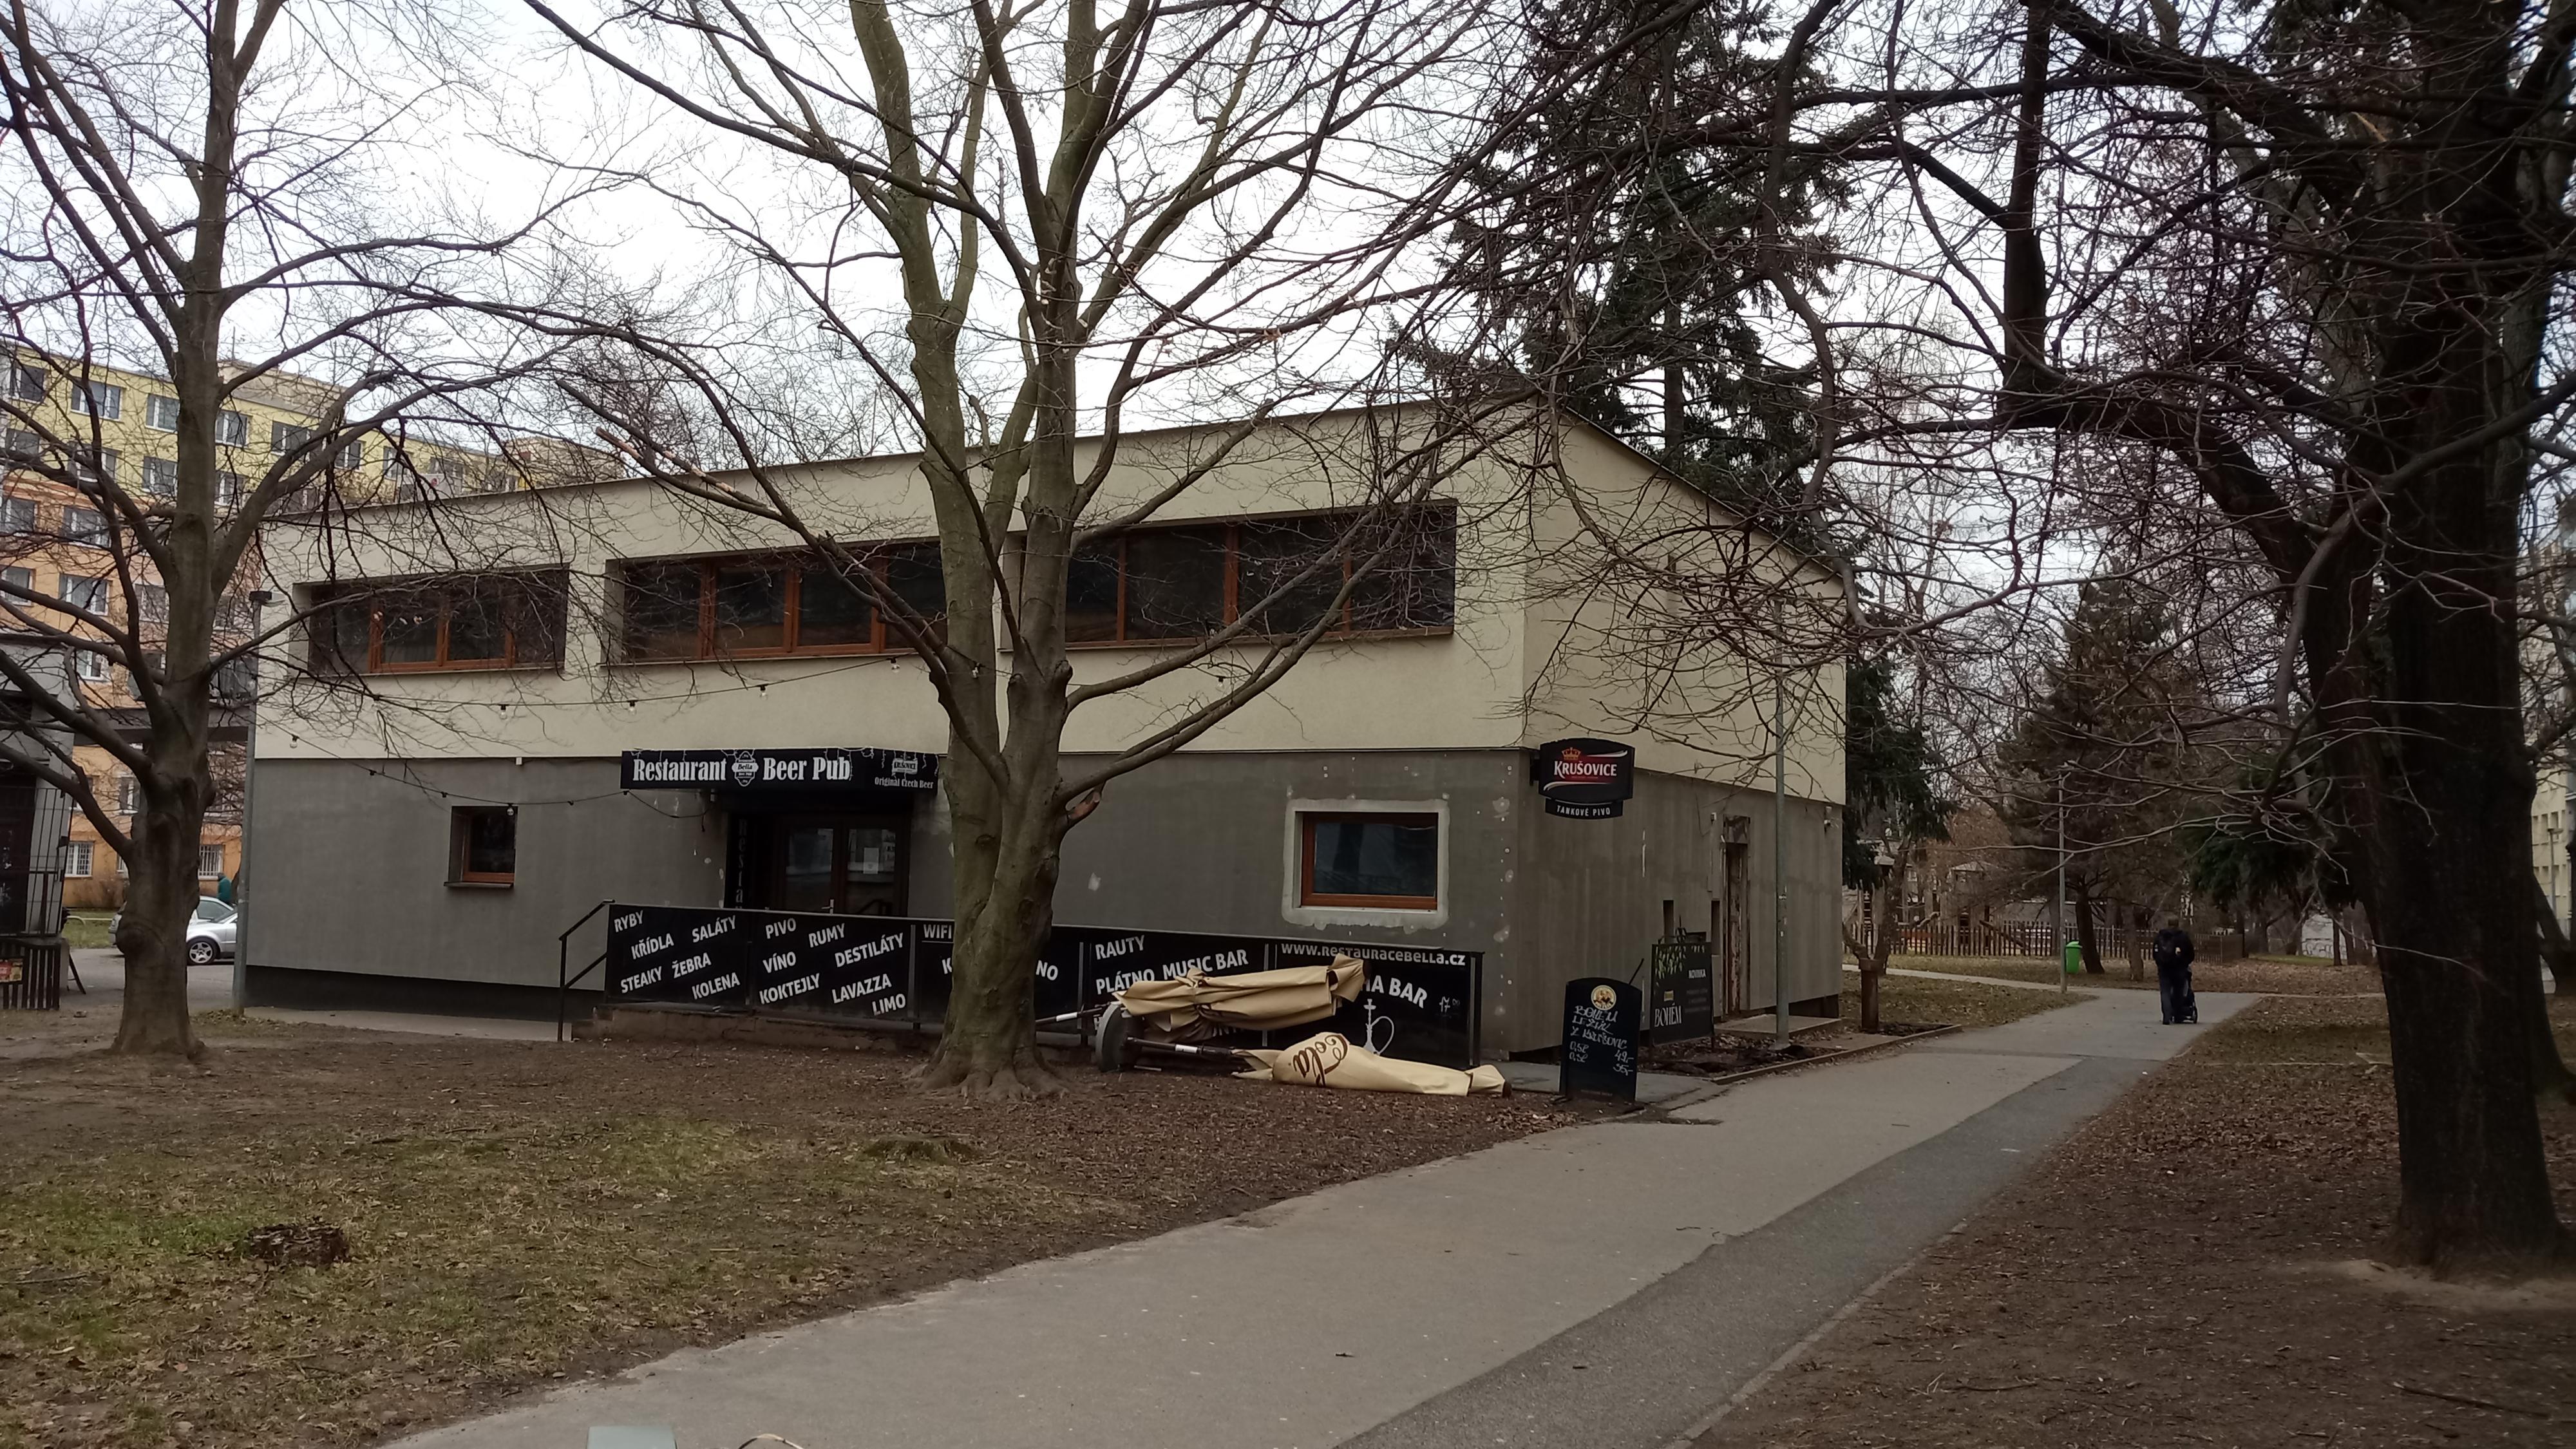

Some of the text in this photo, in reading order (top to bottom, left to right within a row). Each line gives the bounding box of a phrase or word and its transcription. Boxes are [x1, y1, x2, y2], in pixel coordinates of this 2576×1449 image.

[632, 757, 727, 781] Restaurant
[762, 757, 852, 781] Beer Pub
[1553, 761, 1617, 779] KRUŠOVICE
[875, 777, 934, 789] Original Czech Beer
[1557, 805, 1611, 817] TANKOVÉ PIVO
[614, 911, 644, 933] RYBY
[692, 914, 737, 943] SALÁTY
[765, 917, 797, 939] PIVO
[923, 923, 952, 939] WIFI
[630, 933, 674, 960] KŘÍDLA
[808, 923, 846, 948] RUMY
[1095, 935, 1145, 960] RAUTY
[762, 951, 797, 974] VÍNO
[835, 933, 904, 967] DESTILÁTY
[672, 952, 712, 979] ŽEBRA
[1095, 949, 1249, 994] PLÁTNO MUSIC BAR
[620, 966, 663, 994] STEAKY
[692, 972, 741, 1000] KOLENA
[759, 973, 822, 1005] KOKTEJLY
[831, 974, 893, 1004] LAVAZZA
[871, 994, 906, 1016] LIMO
[1388, 978, 1428, 1009] BAR
[1654, 1002, 1682, 1027] BOHÉM
